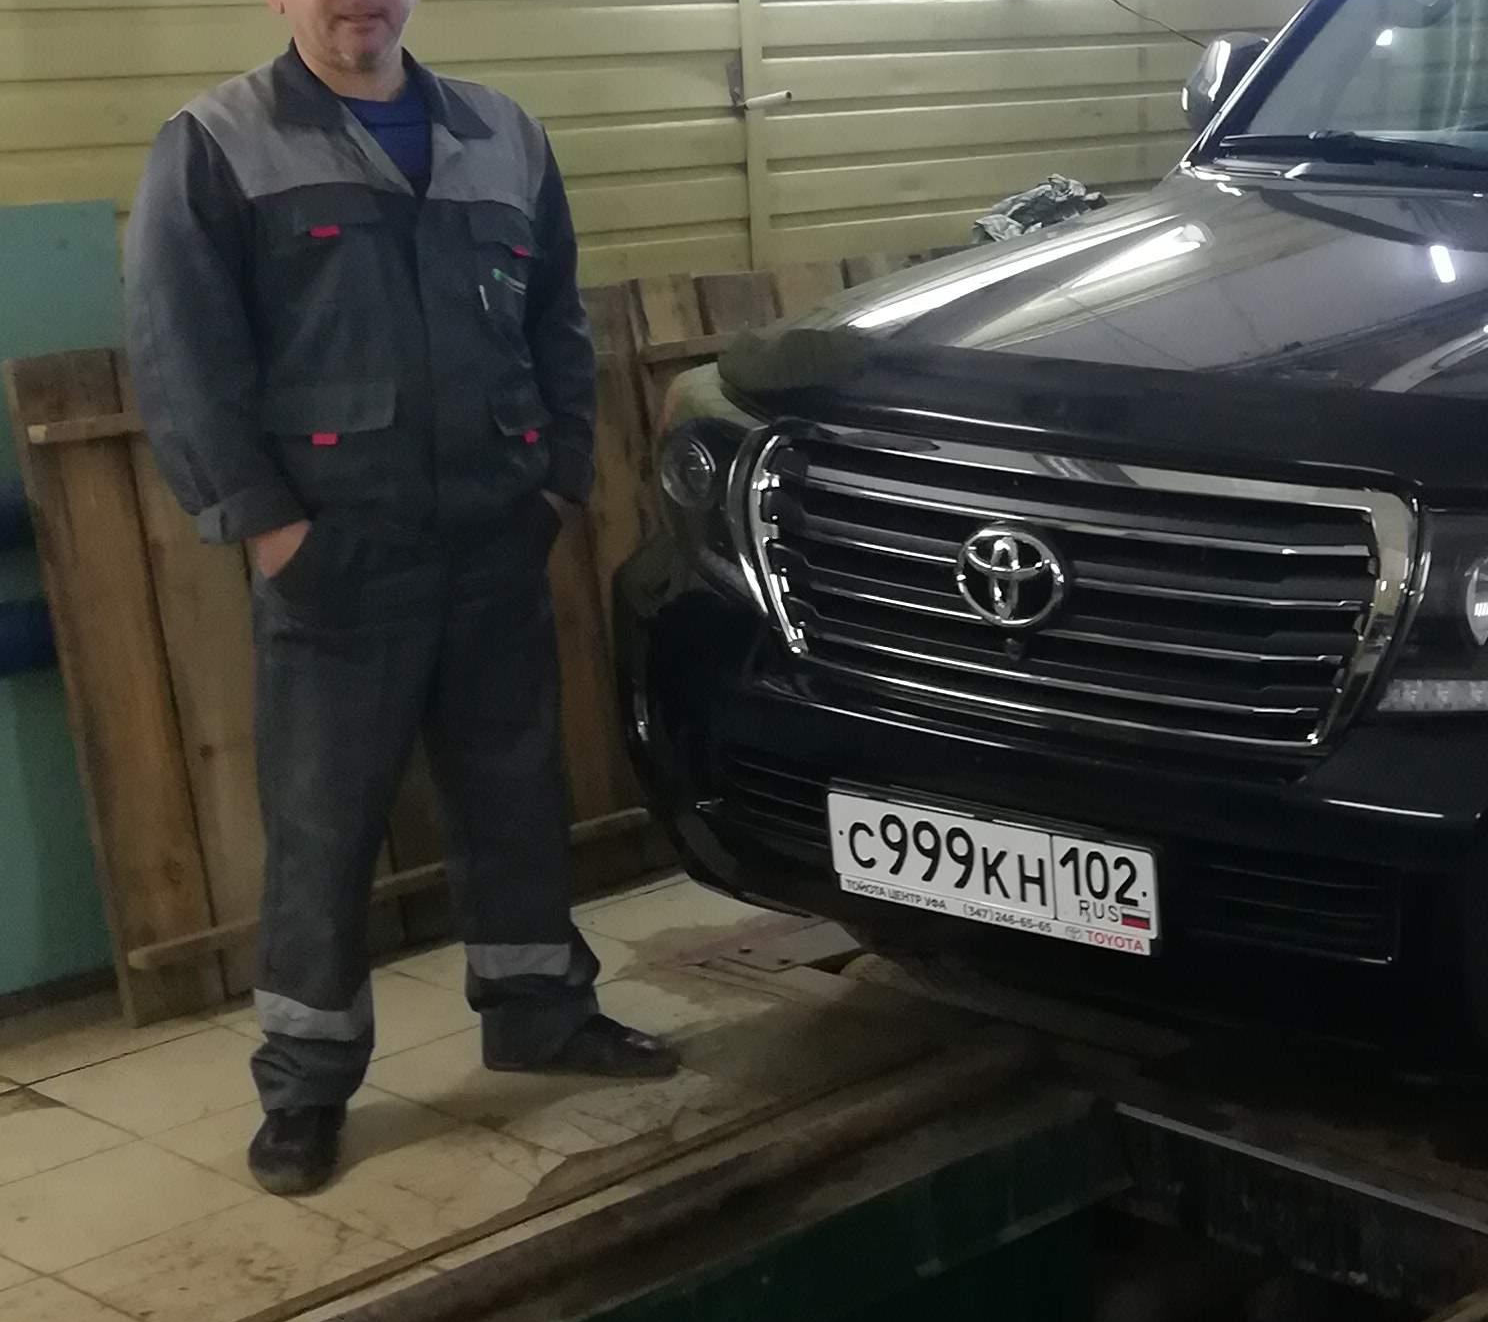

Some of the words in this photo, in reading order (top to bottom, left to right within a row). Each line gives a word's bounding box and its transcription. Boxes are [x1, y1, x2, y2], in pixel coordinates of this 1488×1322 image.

[1059, 847, 1140, 908] 102
[1078, 899, 1120, 923] RUS
[1085, 930, 1145, 952] TOYOTA
